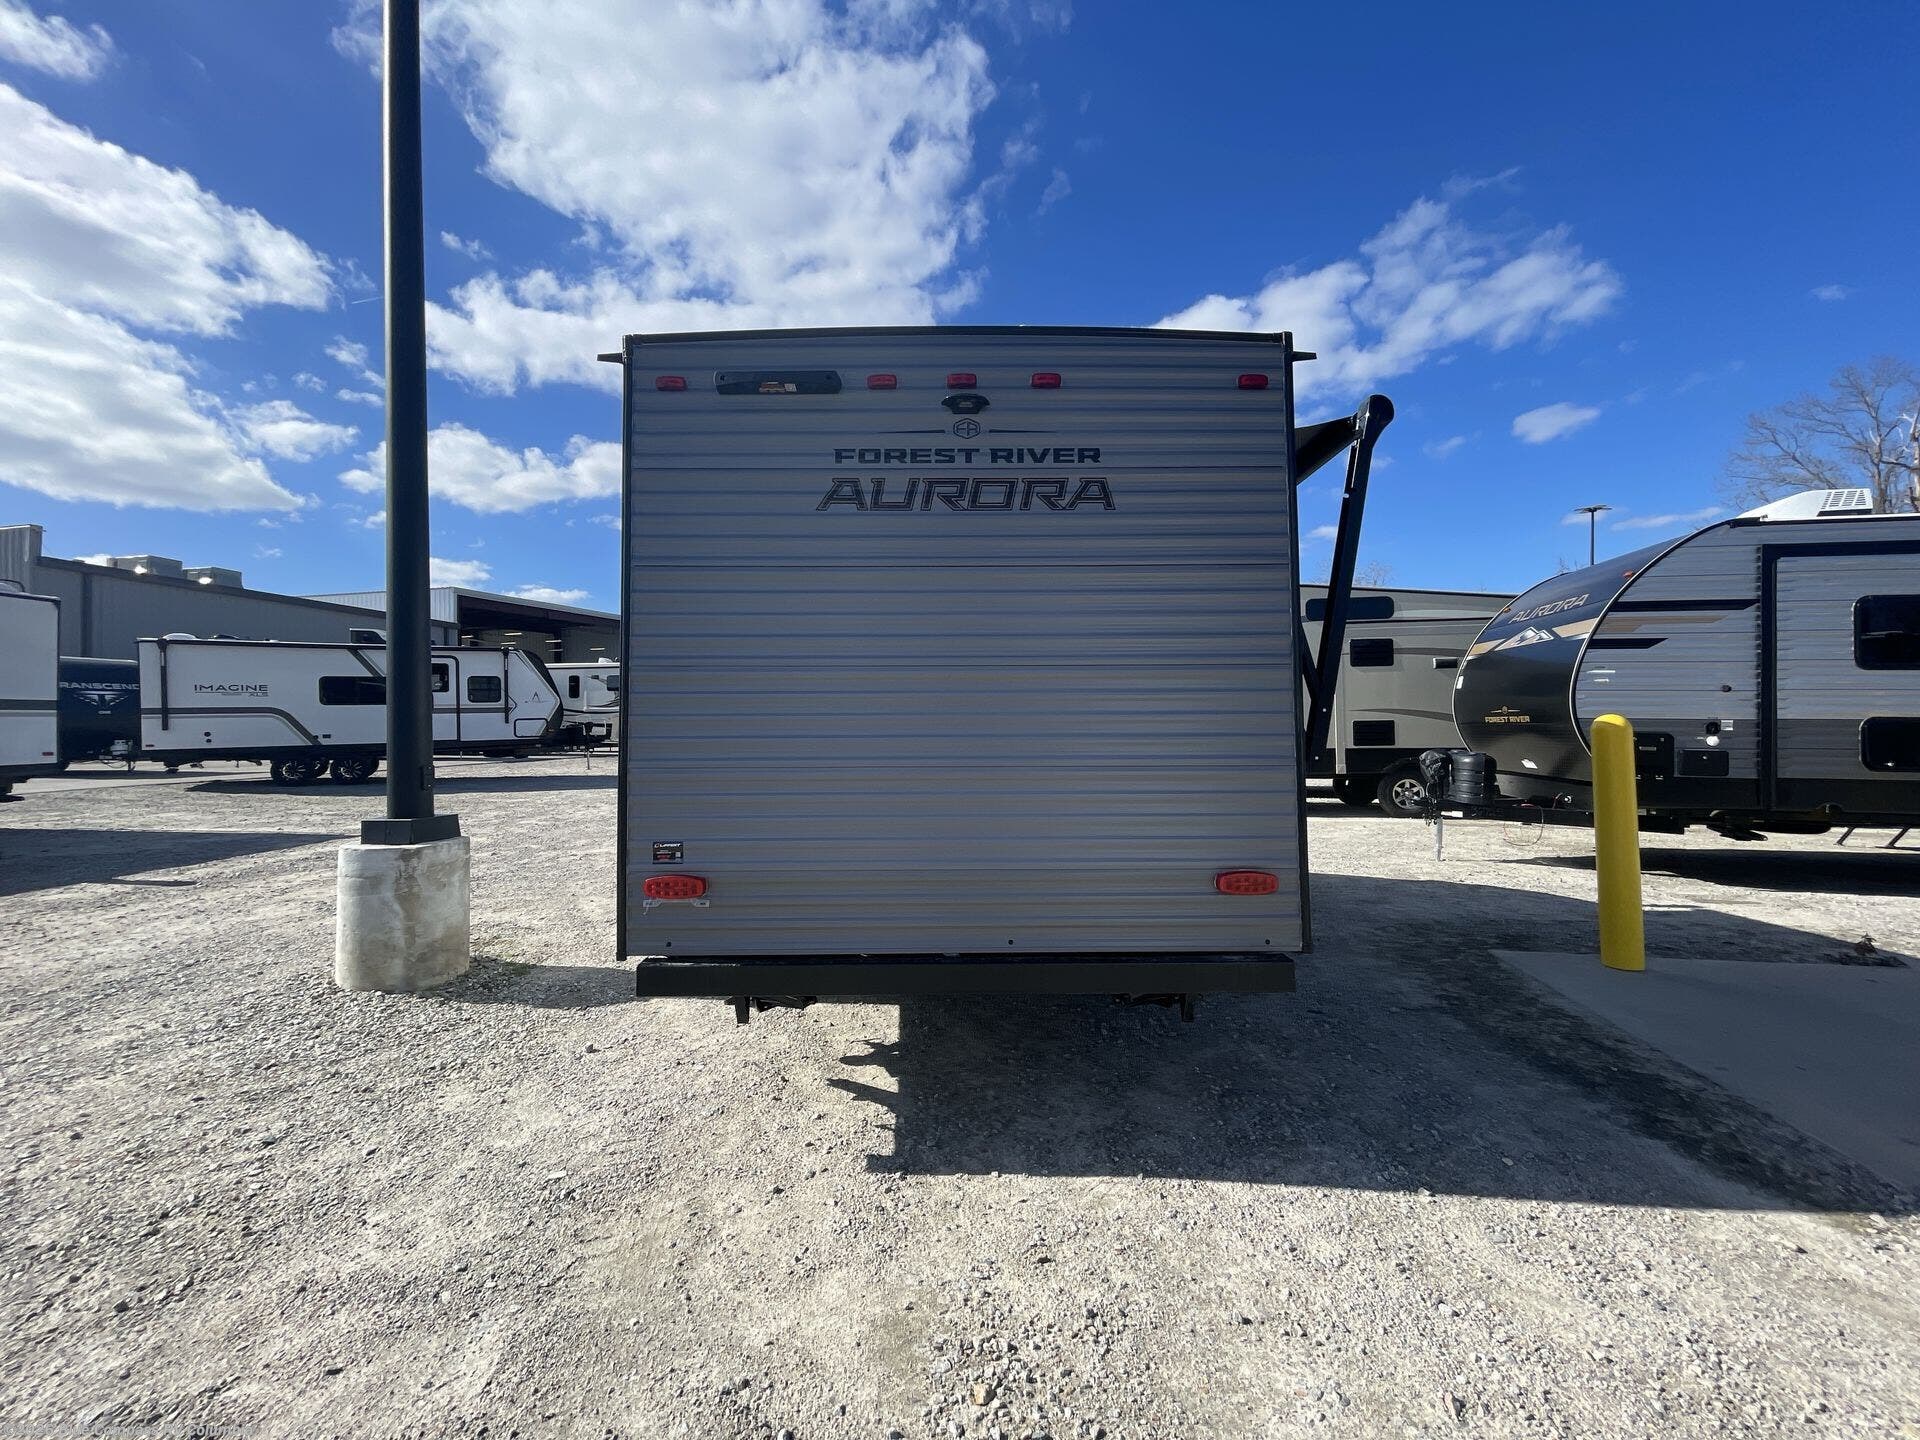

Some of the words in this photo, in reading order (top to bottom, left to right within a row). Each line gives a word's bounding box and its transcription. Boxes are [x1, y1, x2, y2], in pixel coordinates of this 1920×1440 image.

[834, 448, 980, 464] FOREST
[989, 447, 1101, 464] RIVER
[816, 477, 1116, 511] AURORA
[1508, 593, 1590, 624] AURORA
[59, 681, 140, 690] RANSCEND
[194, 684, 269, 692] IMAGINE
[1484, 716, 1508, 724] FOREST
[1509, 715, 1531, 723] RIVER
